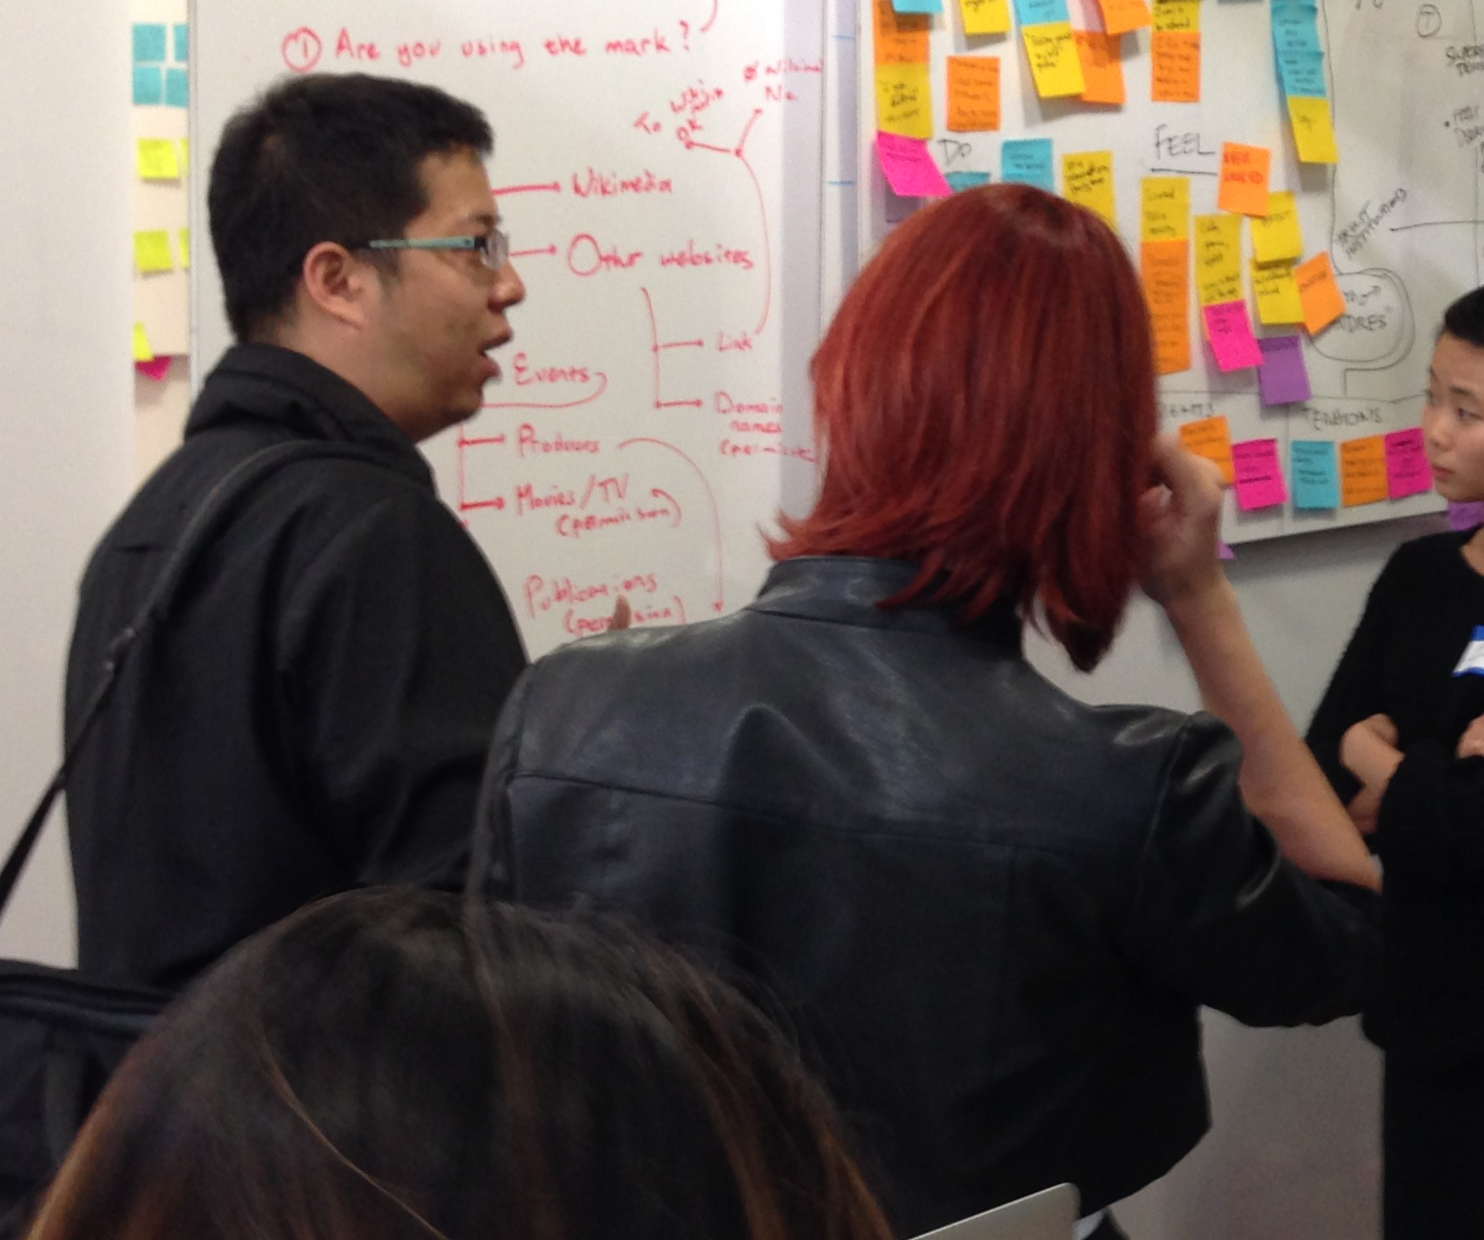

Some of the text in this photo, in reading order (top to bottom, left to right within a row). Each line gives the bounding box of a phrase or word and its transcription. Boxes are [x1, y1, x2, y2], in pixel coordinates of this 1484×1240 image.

[335, 27, 380, 60] Are
[397, 41, 441, 68] you
[461, 35, 525, 69] using
[544, 36, 587, 56] the
[1154, 123, 1215, 160] FEEL
[573, 166, 672, 197] Wikimedia
[568, 233, 643, 277] Other
[513, 352, 591, 385] Events
